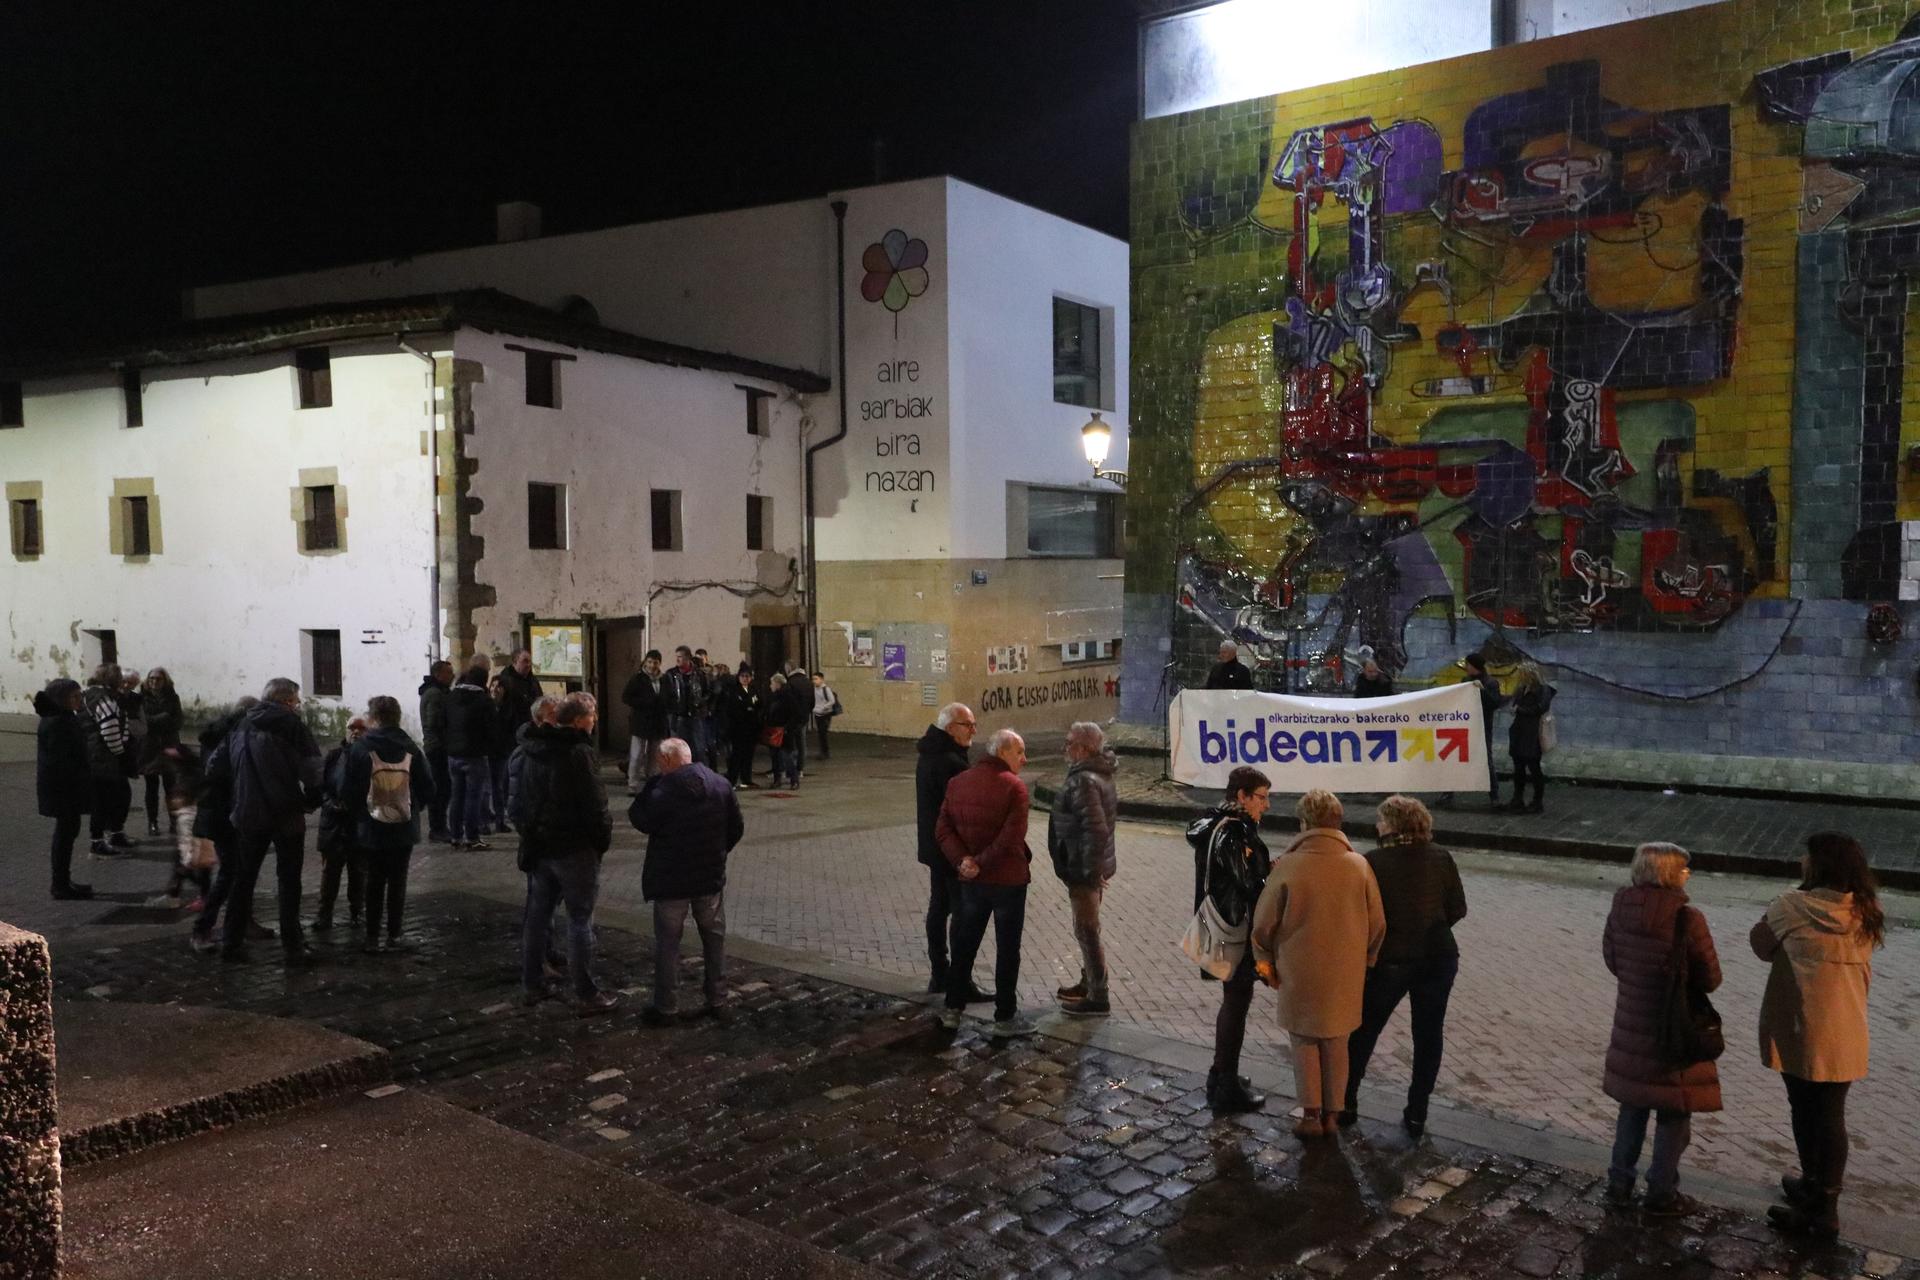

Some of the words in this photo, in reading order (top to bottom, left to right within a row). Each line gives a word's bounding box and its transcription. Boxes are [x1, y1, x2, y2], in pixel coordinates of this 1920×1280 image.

[877, 359, 920, 383] aire
[860, 394, 933, 421] garbiak
[876, 432, 921, 457] bira
[865, 469, 935, 493] nazan
[981, 687, 1013, 713] GORA
[1017, 686, 1049, 708] EUSKO
[1268, 712, 1350, 725] elkarbizitzarako
[1356, 711, 1410, 723] bakerako
[1418, 710, 1471, 722] etxerako
[1198, 717, 1362, 764] bidean
